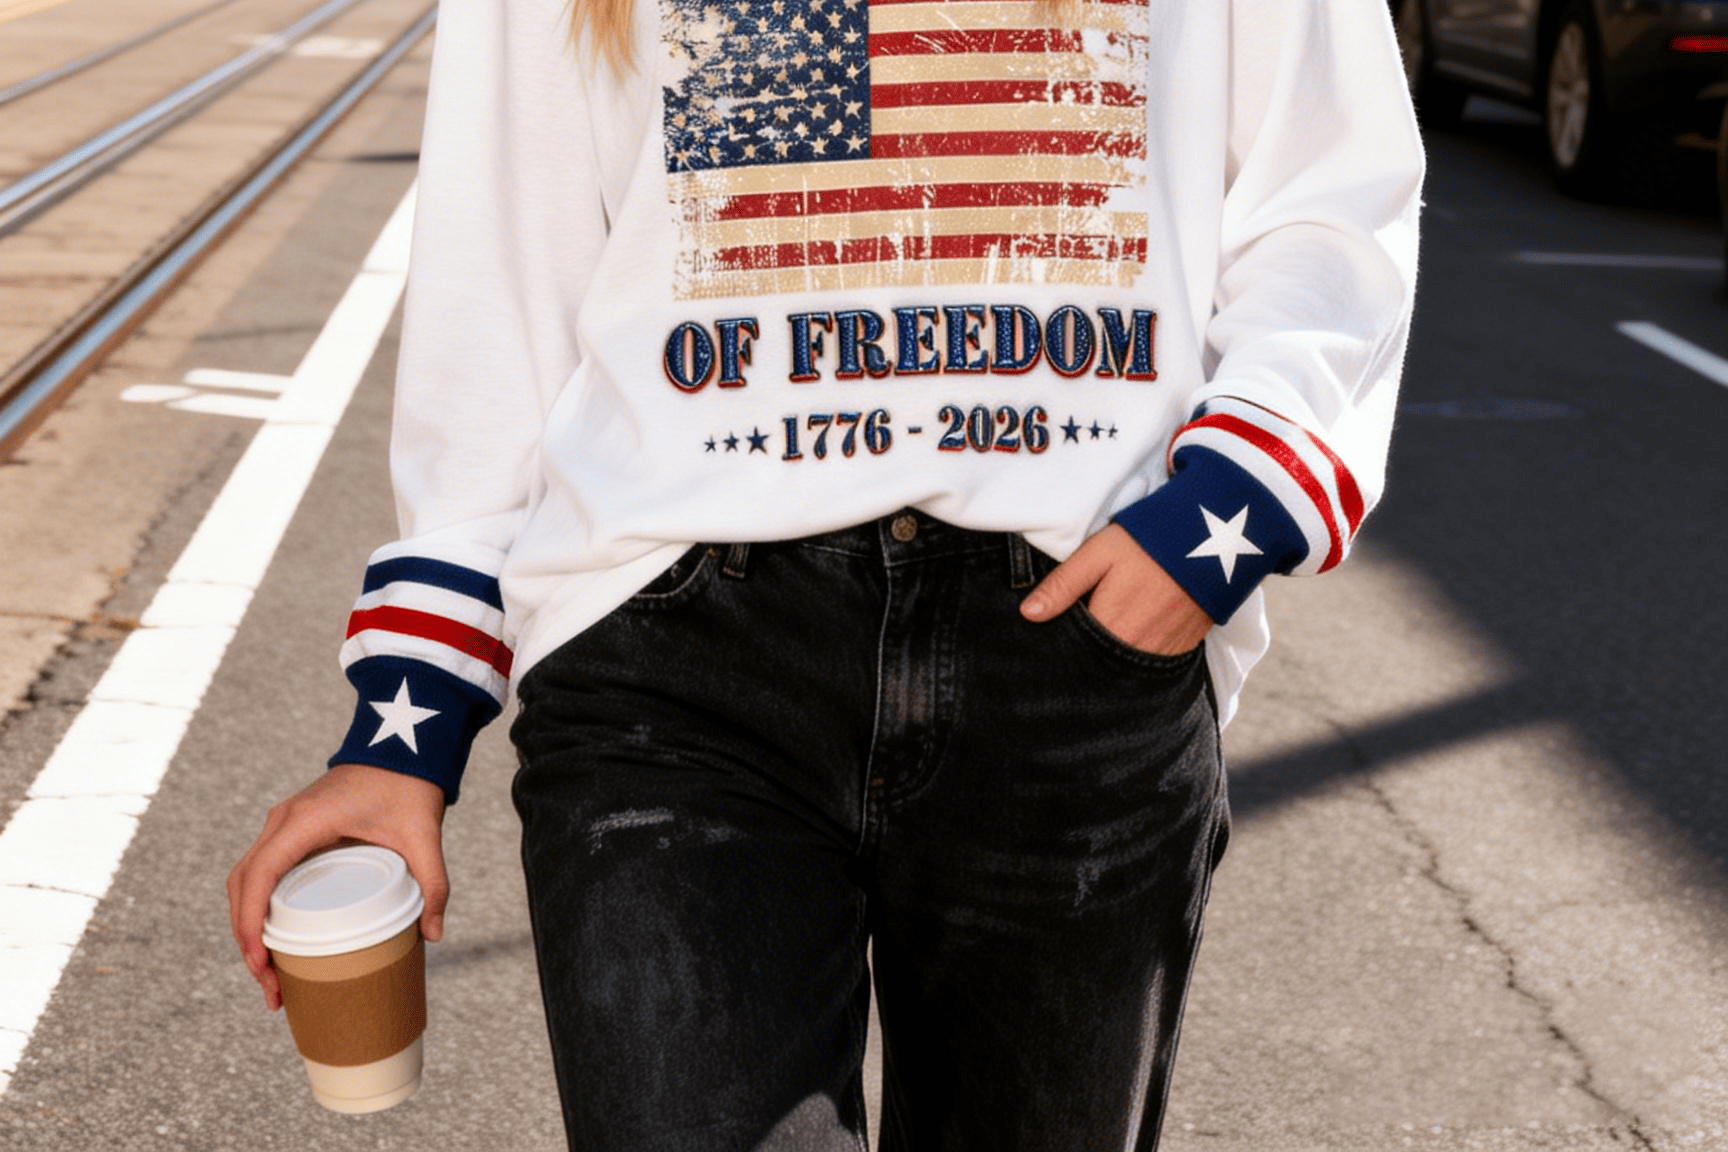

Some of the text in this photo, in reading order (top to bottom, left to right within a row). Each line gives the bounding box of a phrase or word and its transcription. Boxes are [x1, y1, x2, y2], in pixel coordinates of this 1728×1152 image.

[664, 304, 1158, 393] OF FREEDOM
[781, 408, 892, 460] 1776
[938, 405, 1050, 454] 2026
